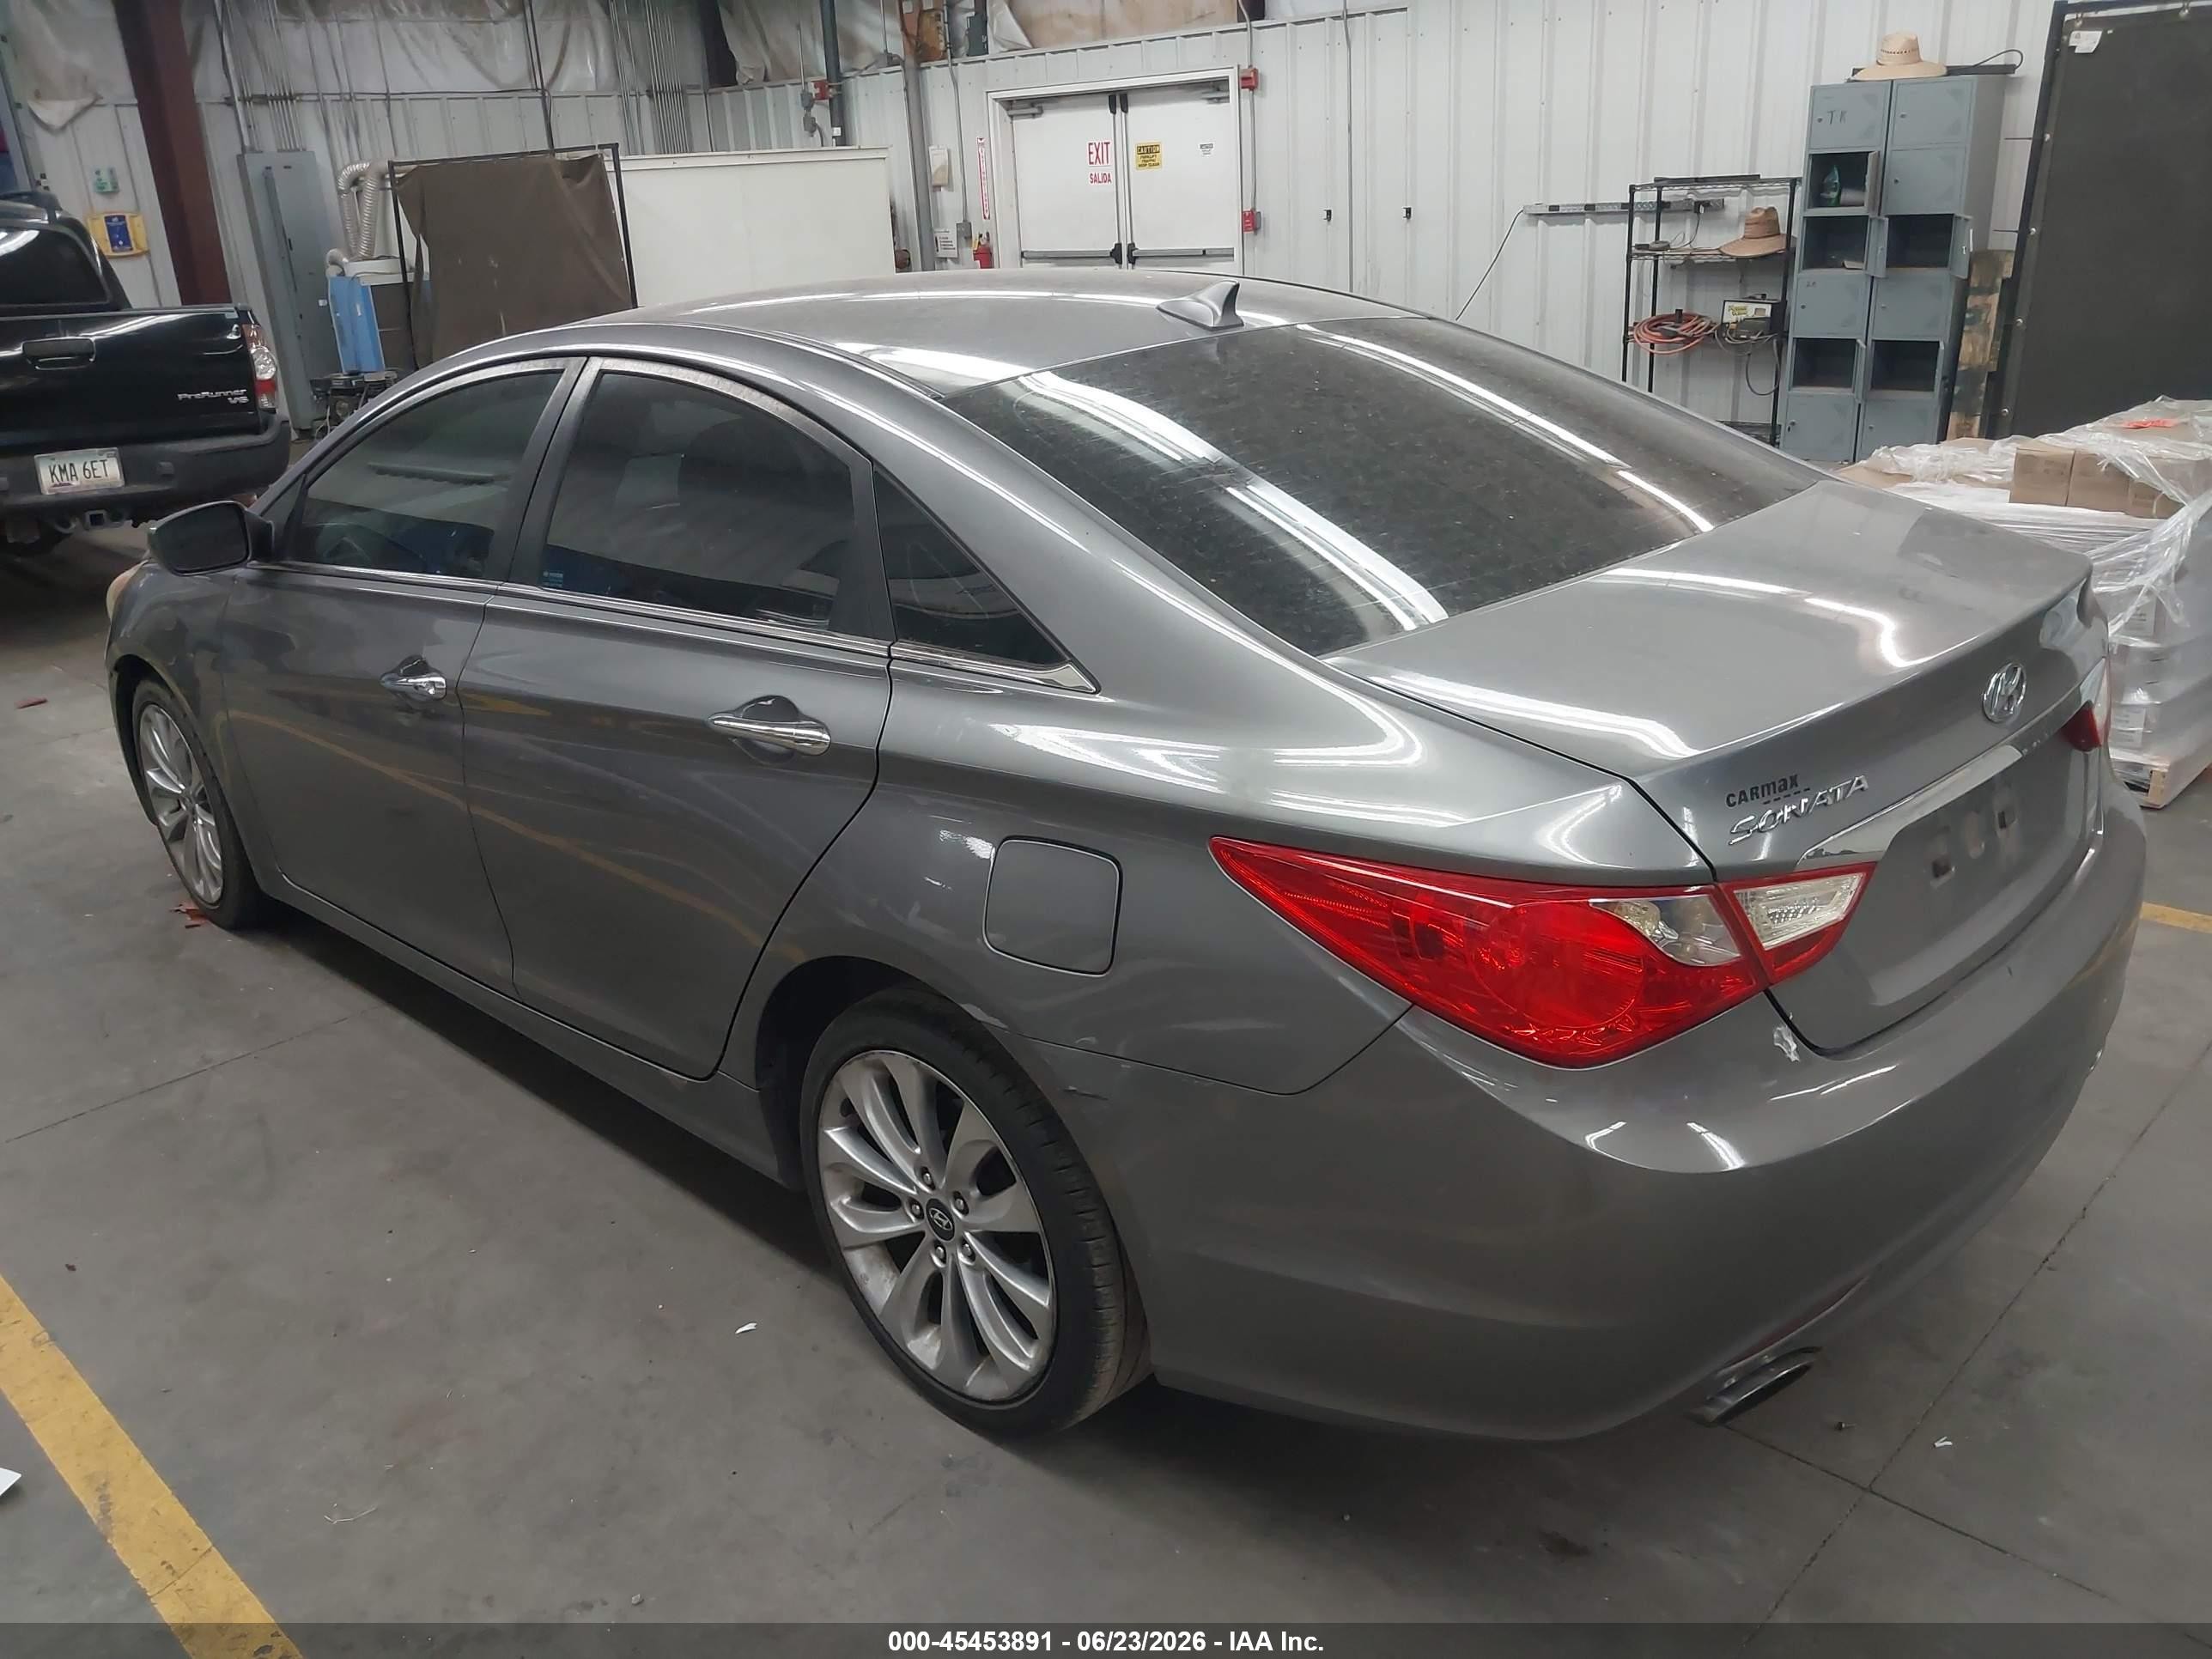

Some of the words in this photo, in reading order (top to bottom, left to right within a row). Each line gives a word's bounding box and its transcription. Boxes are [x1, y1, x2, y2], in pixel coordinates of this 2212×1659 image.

[1088, 142, 1110, 165] EXIT
[1137, 145, 1160, 154] CAUTION
[1090, 173, 1112, 184] SALIDA
[49, 463, 78, 483] KMA
[83, 459, 108, 479] 6ET
[1729, 775, 1869, 845] SONATA
